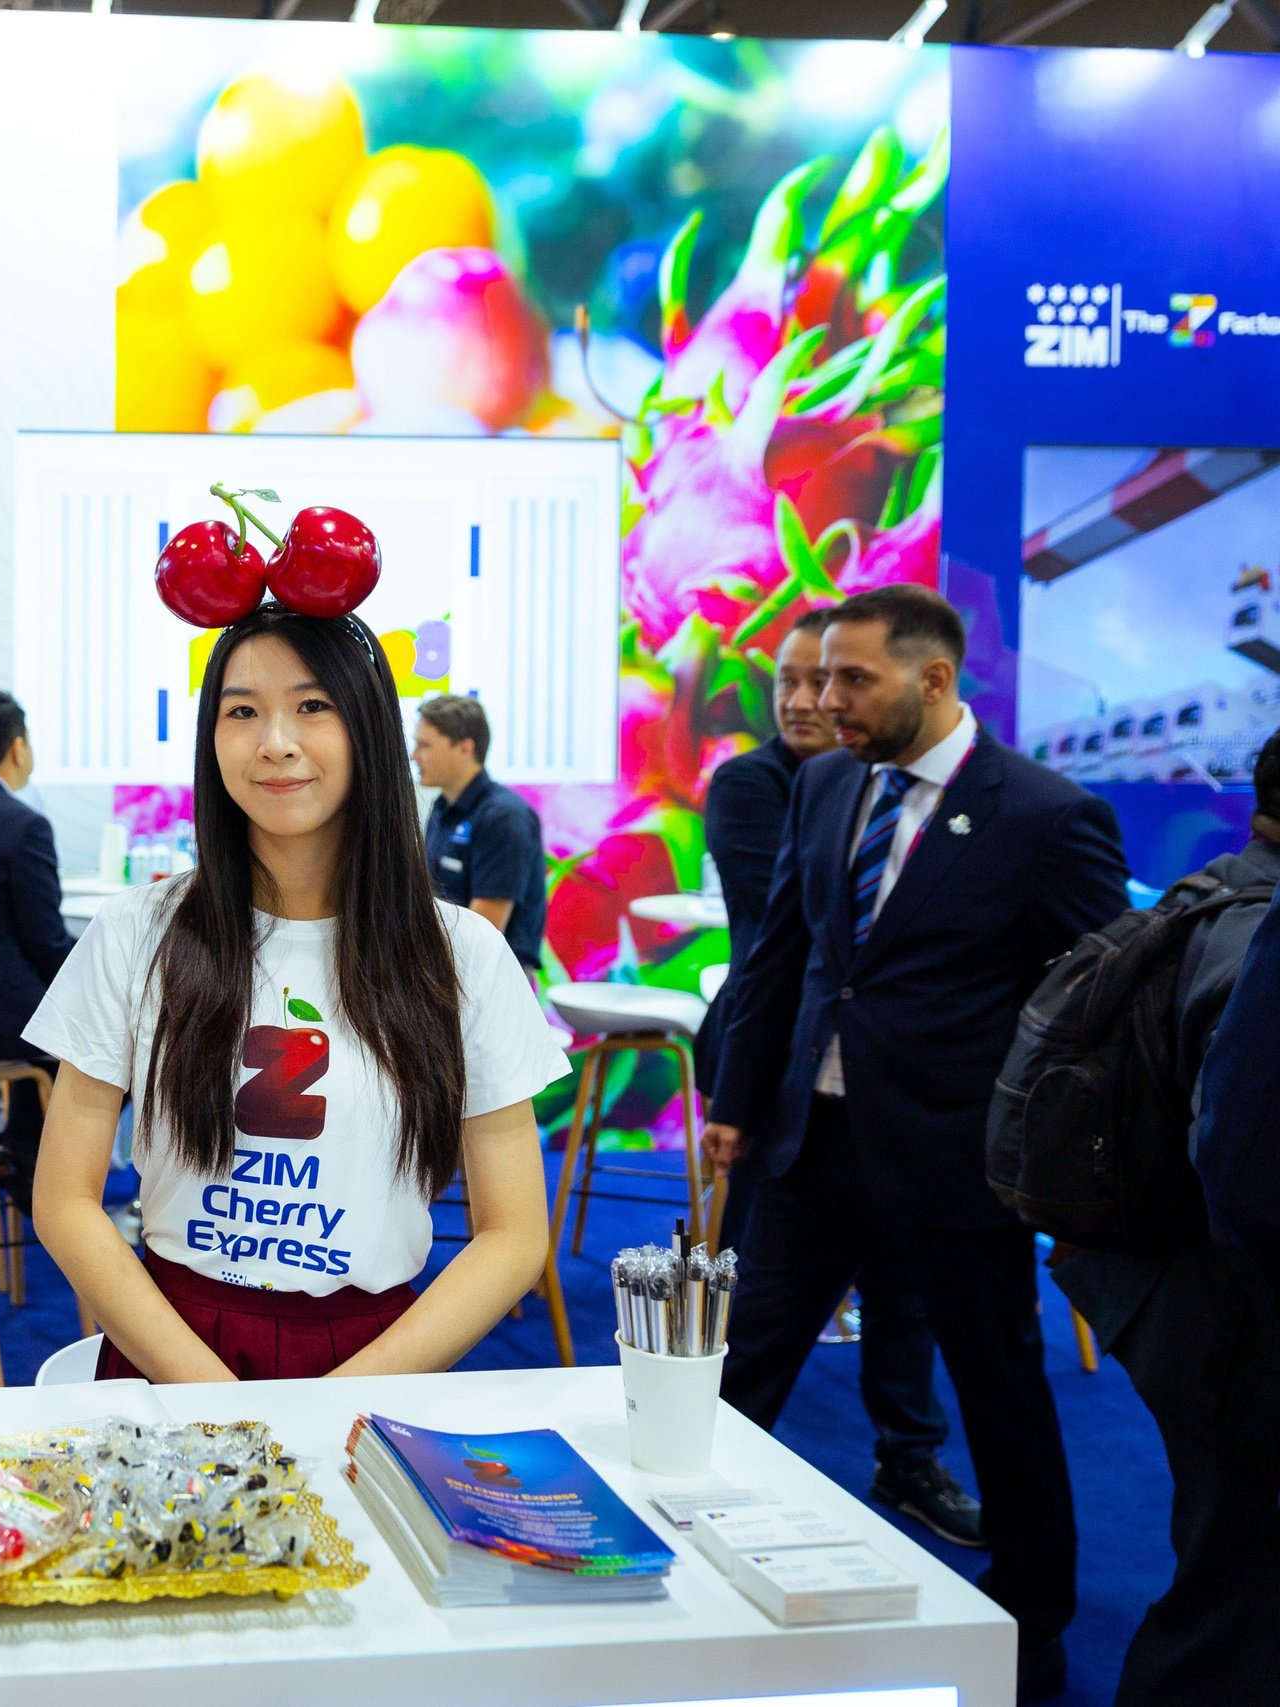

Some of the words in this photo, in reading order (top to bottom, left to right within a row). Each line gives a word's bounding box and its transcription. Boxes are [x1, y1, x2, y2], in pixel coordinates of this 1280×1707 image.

[1122, 309, 1169, 334] The
[1218, 311, 1280, 336] Facto
[1023, 324, 1111, 368] ZIM
[231, 1149, 320, 1190] ZIM
[201, 1184, 346, 1239] Cherry
[186, 1219, 352, 1276] Express
[521, 1493, 579, 1502] Express
